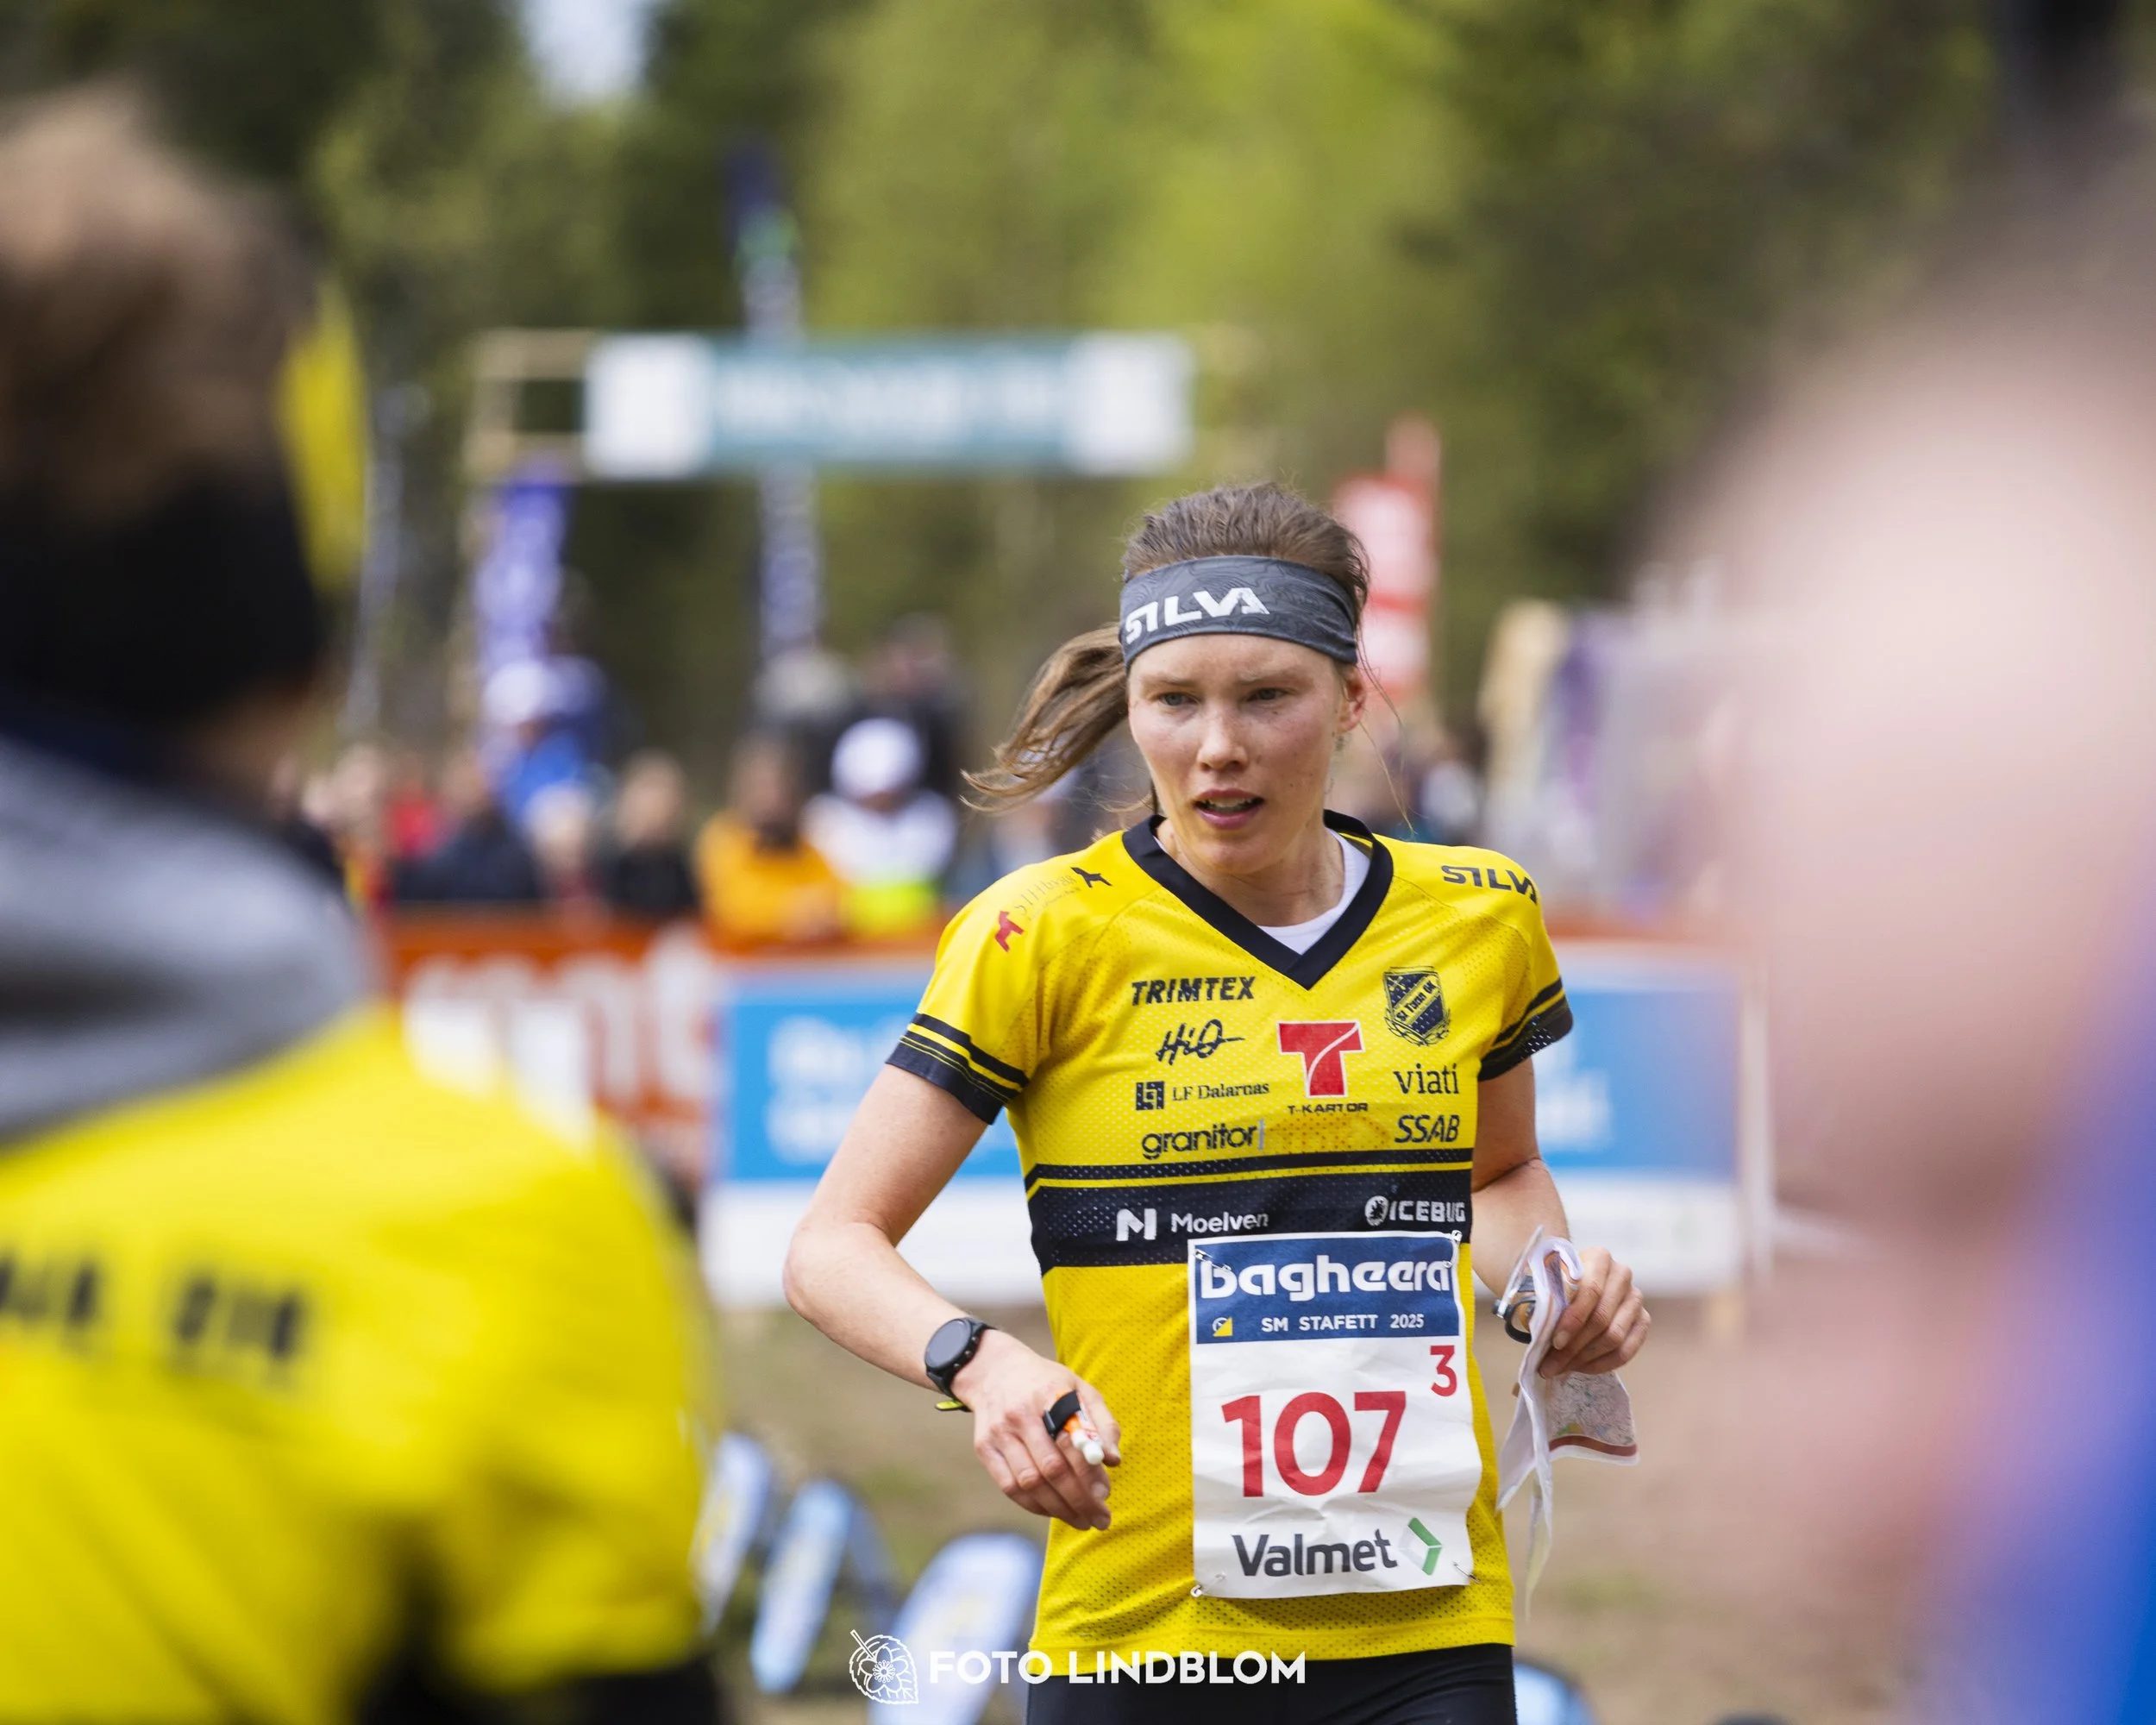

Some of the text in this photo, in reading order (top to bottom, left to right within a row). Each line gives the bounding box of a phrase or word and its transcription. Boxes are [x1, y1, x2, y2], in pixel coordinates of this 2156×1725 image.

[1125, 586, 1270, 645] SILVA
[1441, 865, 1538, 906] SILVA
[1131, 975, 1256, 1006] TRIMTEX
[1156, 1019, 1245, 1065] HiQ
[1172, 1082, 1270, 1101] LF Dalarnas
[1393, 1063, 1460, 1095] viati
[1288, 1102, 1369, 1114] T-KARTOR
[1142, 1122, 1257, 1160] granitor
[1394, 1113, 1461, 1144] SSAB
[1170, 1211, 1269, 1233] Moelven
[1389, 1200, 1466, 1223] ICEBUG
[1200, 1254, 1451, 1302] bagheera
[1261, 1313, 1425, 1333] SM STAFETT 2025
[1429, 1345, 1458, 1397] 3
[1221, 1390, 1407, 1497] 107
[1231, 1528, 1398, 1577] Valmet
